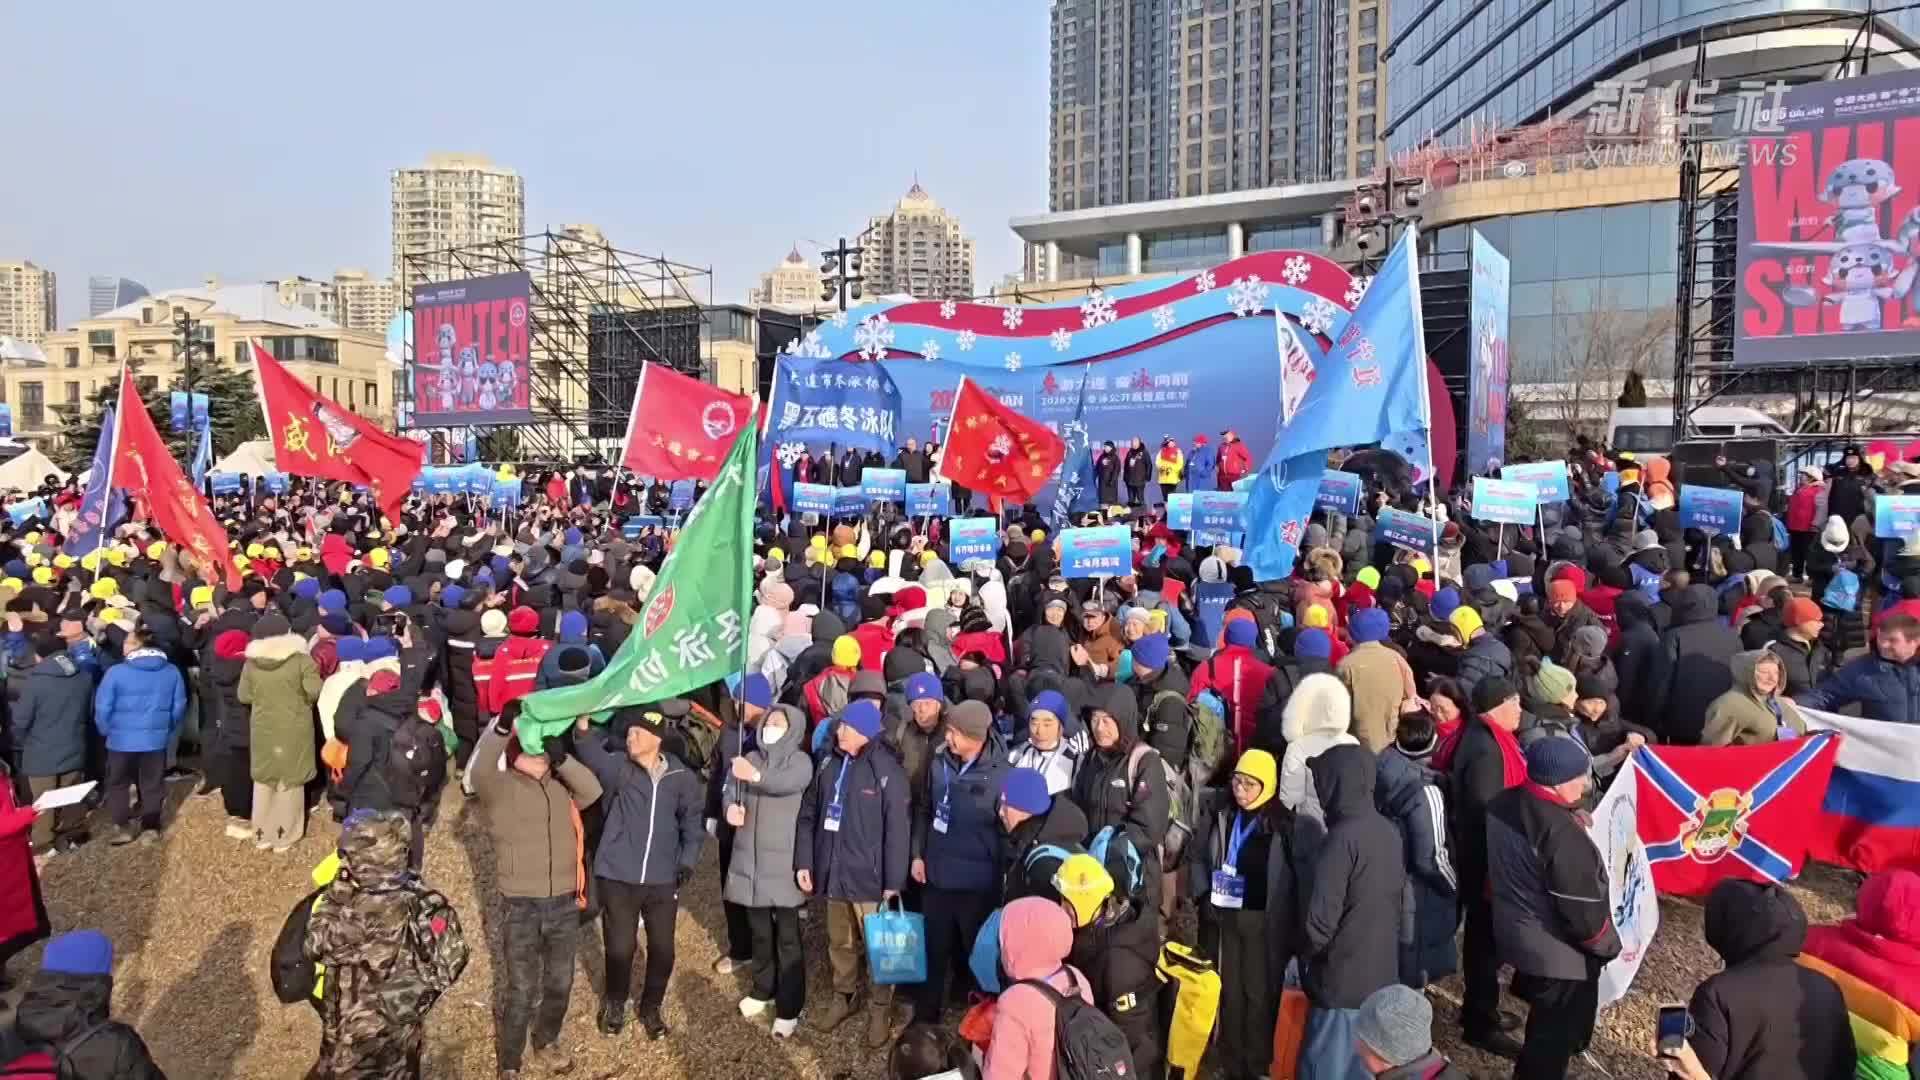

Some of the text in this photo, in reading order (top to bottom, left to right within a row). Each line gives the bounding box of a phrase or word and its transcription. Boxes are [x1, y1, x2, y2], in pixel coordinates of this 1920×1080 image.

[777, 400, 895, 441] 黑石礁冬泳队
